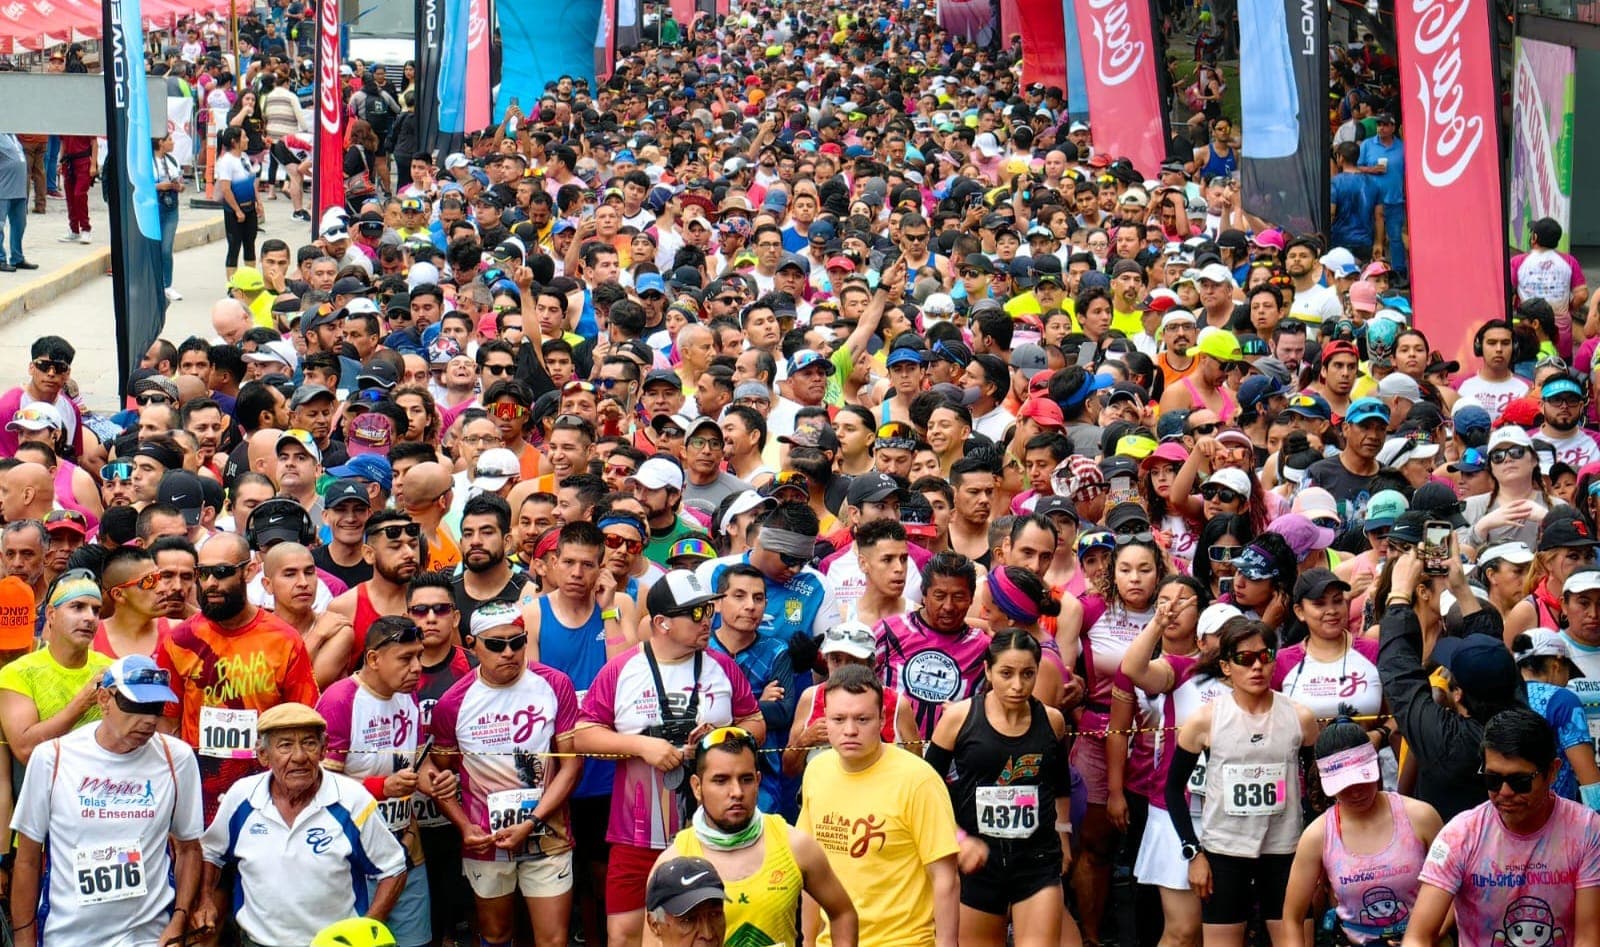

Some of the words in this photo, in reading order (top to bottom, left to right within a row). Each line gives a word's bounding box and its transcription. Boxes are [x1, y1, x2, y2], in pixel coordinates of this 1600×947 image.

[110, 0, 125, 108] POWE
[214, 651, 267, 682] BAJA
[204, 725, 251, 749] 1001
[78, 795, 107, 807] Telas
[1233, 782, 1277, 807] 836
[81, 808, 96, 818] de
[98, 808, 155, 819] Ensenada
[981, 804, 1035, 829] 4376
[78, 862, 141, 895] 5676
